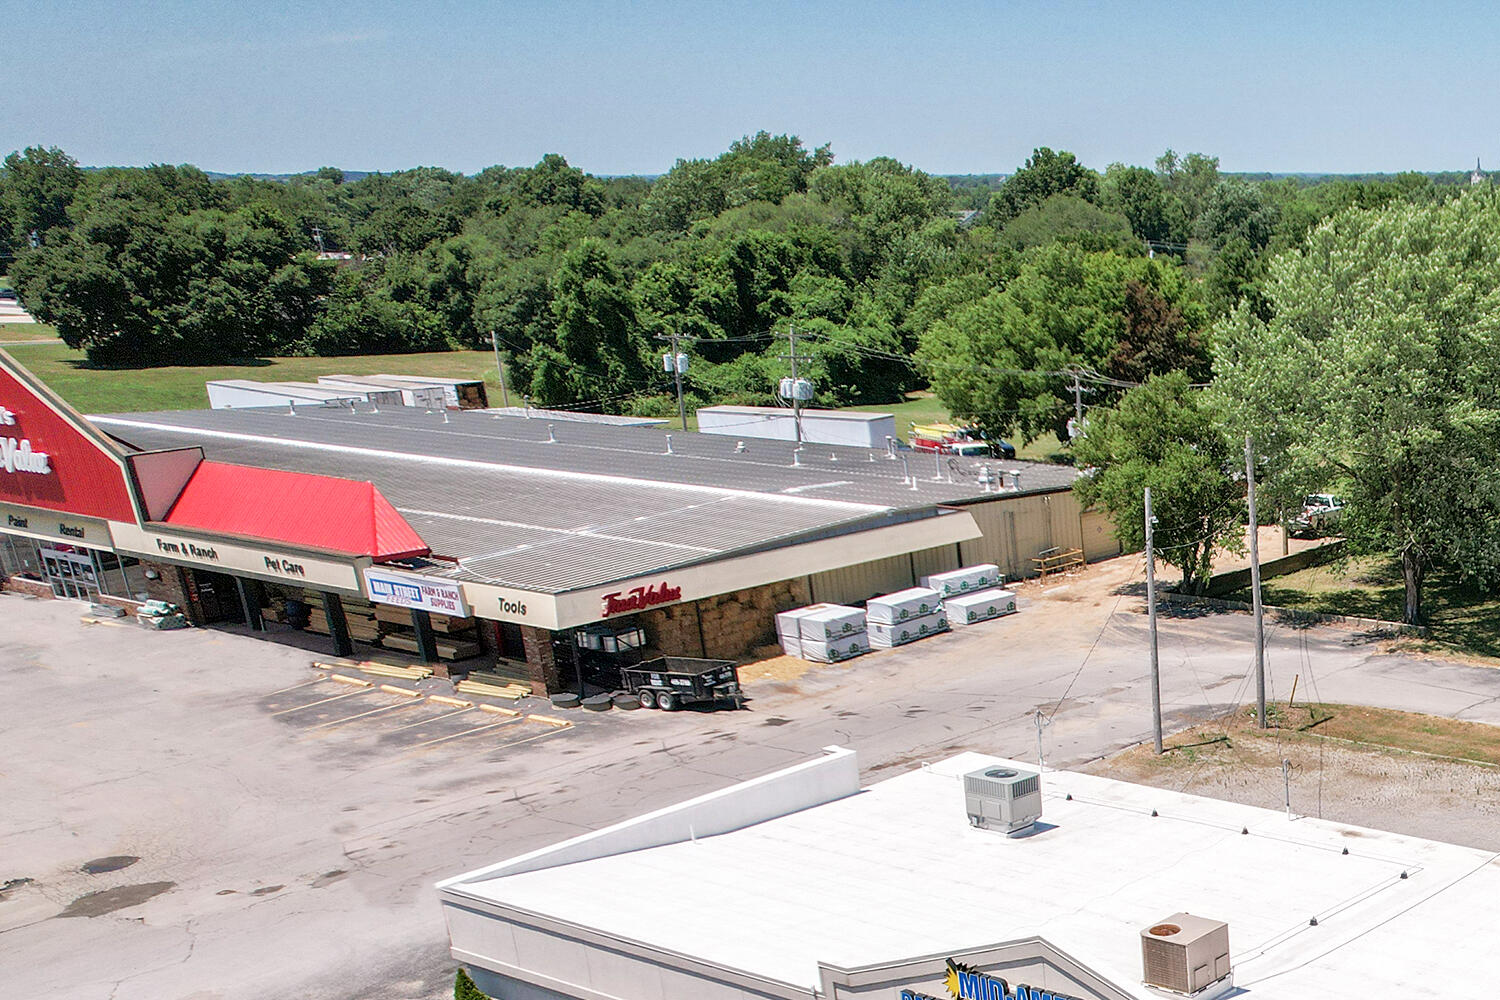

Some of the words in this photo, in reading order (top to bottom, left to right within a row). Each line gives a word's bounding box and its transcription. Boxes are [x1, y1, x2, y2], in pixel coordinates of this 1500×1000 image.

[8, 514, 28, 528] Paint
[59, 523, 85, 538] Rental
[156, 538, 180, 553] Farm
[180, 542, 188, 556] &
[189, 544, 219, 560] Ranch
[264, 556, 281, 573] Pet
[282, 559, 305, 576] Care
[430, 597, 456, 611] SUPPLIES
[498, 597, 527, 616] Tools
[601, 592, 639, 617] True
[629, 581, 682, 609] Value
